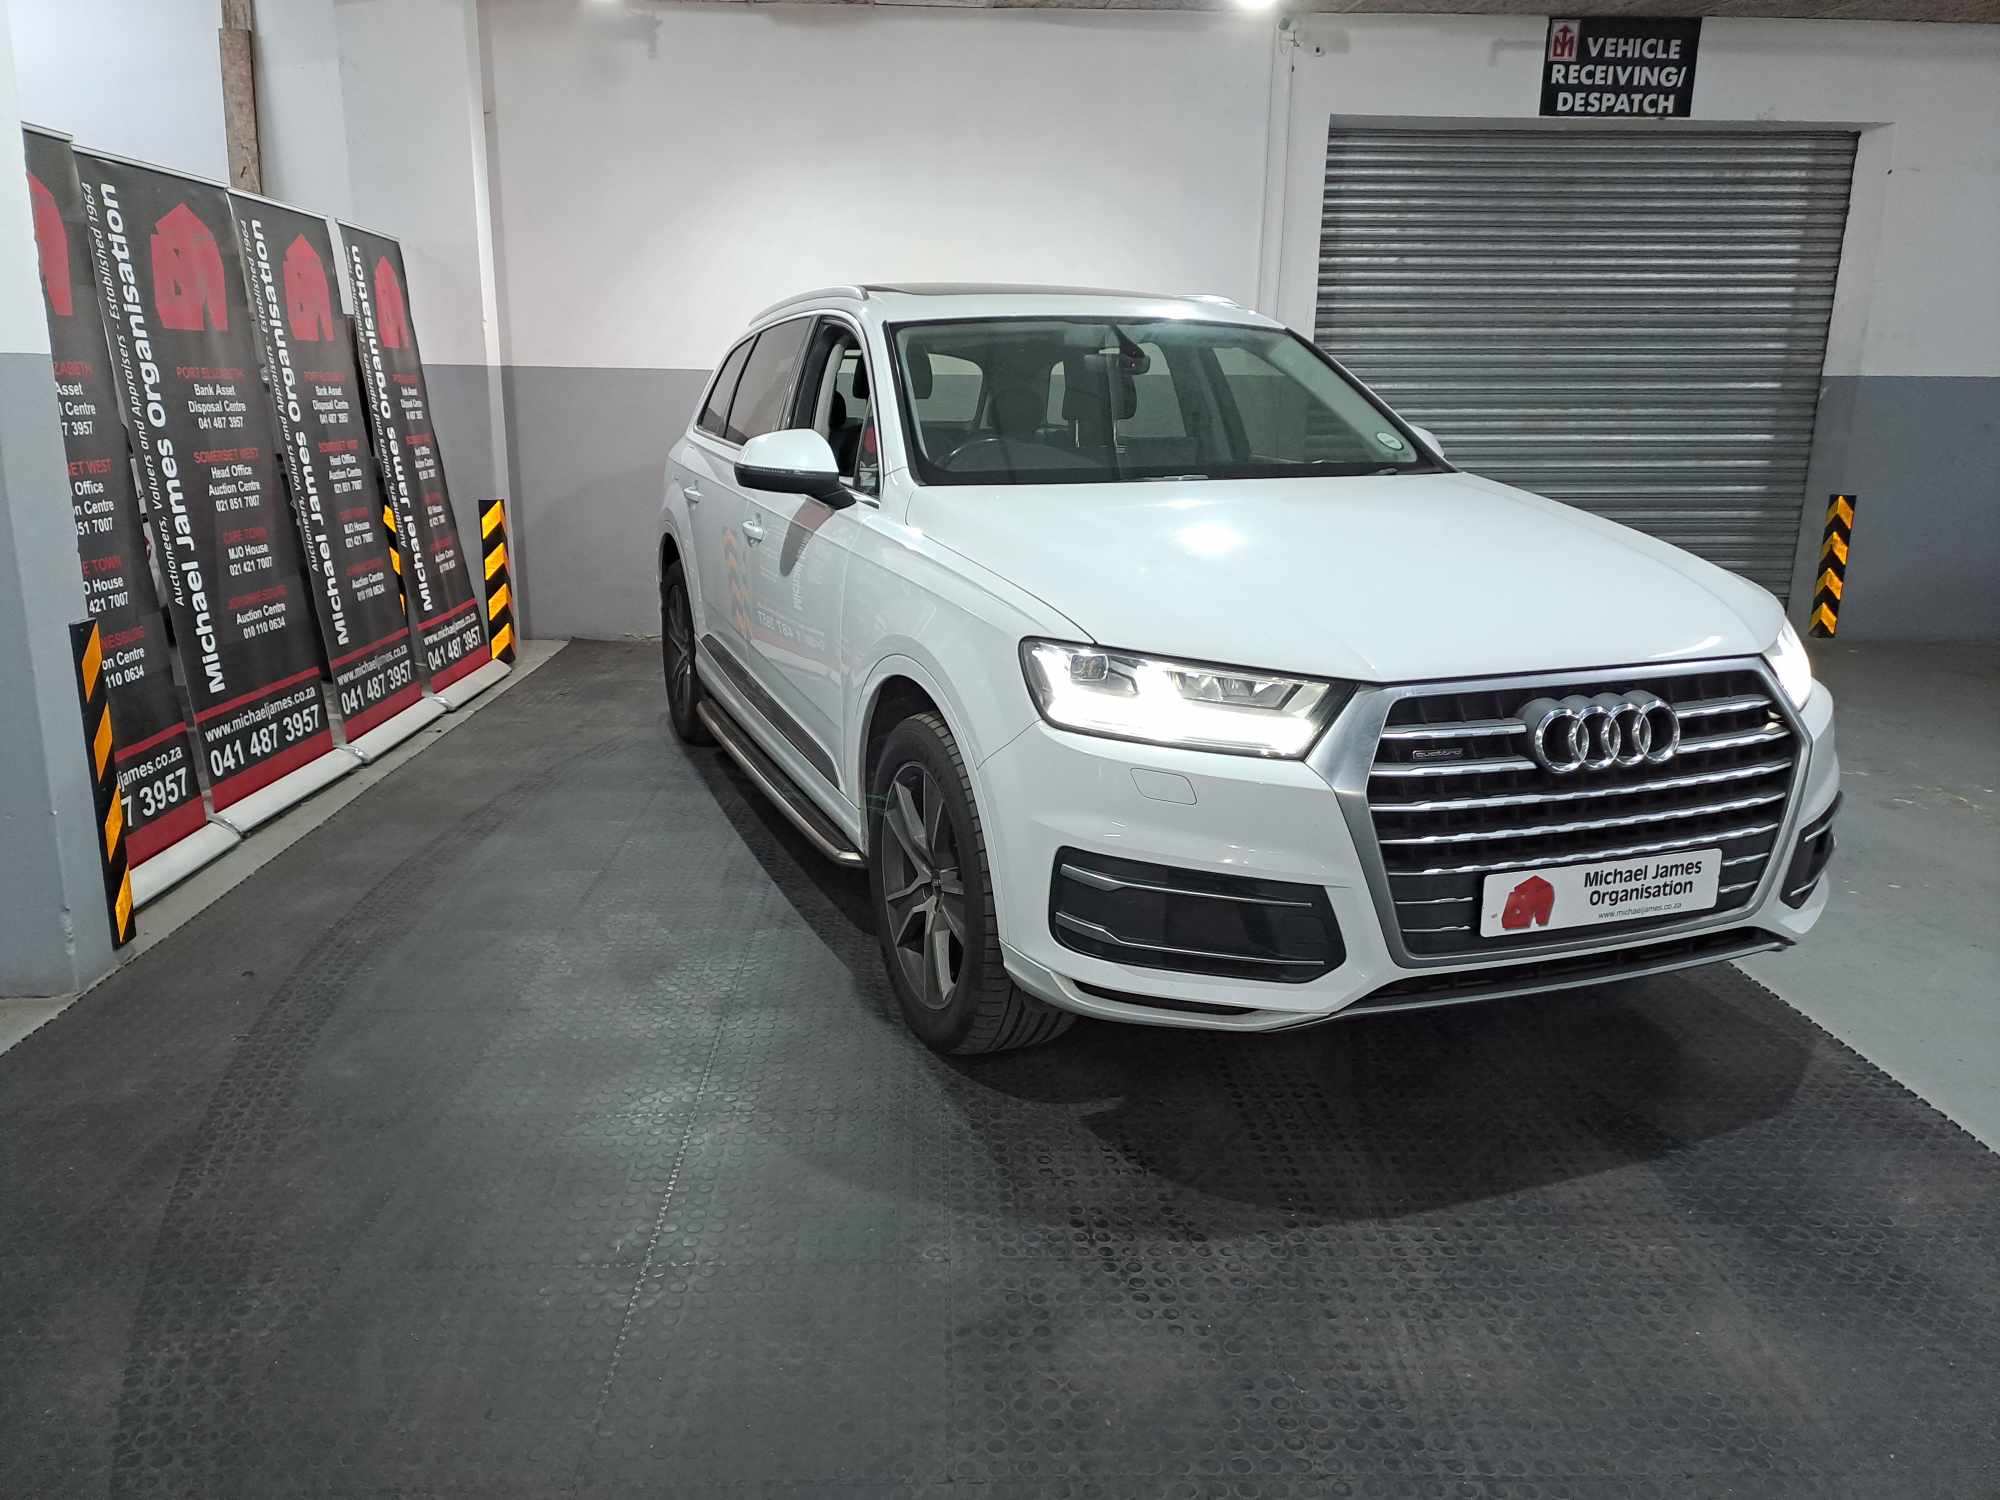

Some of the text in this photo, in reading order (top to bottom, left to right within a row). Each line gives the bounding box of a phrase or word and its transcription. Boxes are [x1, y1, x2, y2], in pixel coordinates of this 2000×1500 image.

[1587, 37, 1682, 60] VEHICLE
[1551, 64, 1687, 88] RECEIVING/
[1556, 92, 1676, 114] DESPATCH
[81, 182, 101, 226] 1964
[90, 227, 120, 321] Established
[351, 244, 391, 419] Organisation
[116, 335, 141, 417] Appraisers
[56, 382, 83, 396] Asset
[194, 384, 215, 396] Bank
[65, 402, 96, 416] Centre
[188, 400, 246, 415] Disposal Centre
[72, 421, 94, 436] 3957
[133, 419, 150, 450] and
[198, 417, 212, 430] 041
[213, 417, 226, 429] 487
[252, 219, 349, 645] Michael James Organisation
[281, 421, 291, 441] and
[100, 183, 225, 694] Michael James Organisation
[211, 464, 252, 479] Head Office
[287, 445, 301, 491] Valuers
[387, 427, 411, 508] James
[74, 480, 104, 497] Office
[146, 454, 163, 510] Valuers
[208, 480, 260, 496] Auction Centre
[84, 500, 114, 515] Centre
[92, 517, 113, 532] 7007
[245, 544, 268, 556] House
[229, 557, 272, 576] 021 421 7007
[403, 515, 433, 611] Michael
[92, 576, 124, 593] House
[89, 591, 129, 614] 421 7007
[236, 603, 286, 624] Auction Centre
[116, 646, 145, 666] Centre
[428, 626, 481, 670] 041 487 3957
[105, 672, 122, 688] 110
[124, 664, 145, 682] 0634
[340, 660, 412, 715] 041 487 3957
[204, 685, 316, 743] www.michaeljames.co.za
[210, 704, 320, 777] 041 487 3957
[116, 745, 184, 793] ljames.co.za
[139, 766, 188, 817] 3957
[1584, 859, 1703, 888] Michael James
[1589, 879, 1693, 907] Organisation
[1598, 902, 1682, 919] www.michaeljames.co.za
